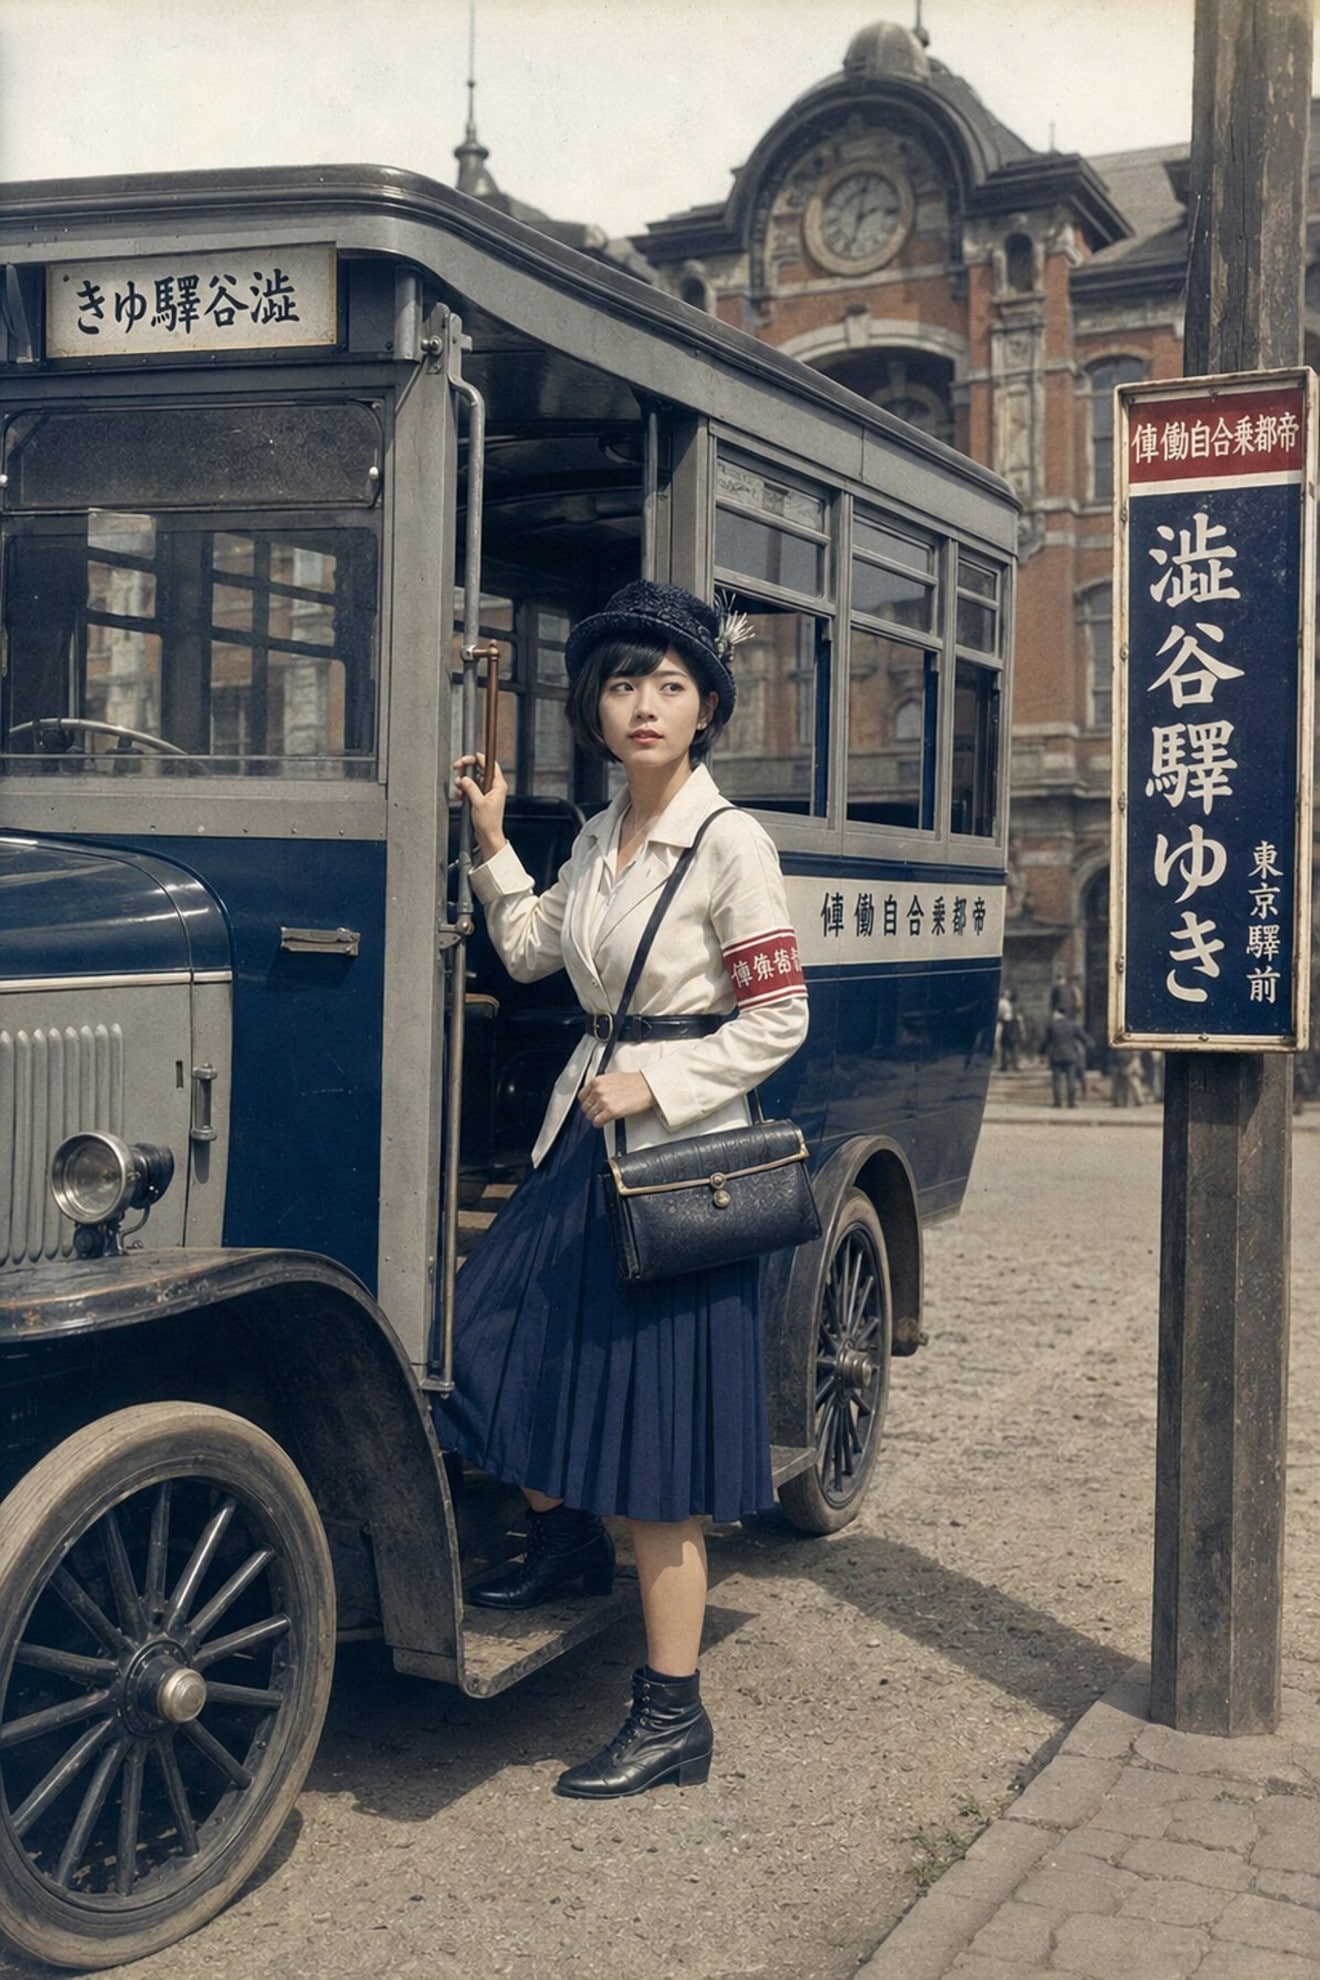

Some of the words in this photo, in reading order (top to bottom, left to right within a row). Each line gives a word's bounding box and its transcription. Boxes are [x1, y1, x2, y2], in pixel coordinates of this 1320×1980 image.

[1145, 512, 1246, 1003] 澁谷驛ゆき
[1245, 840, 1284, 1004] 東京驛前
